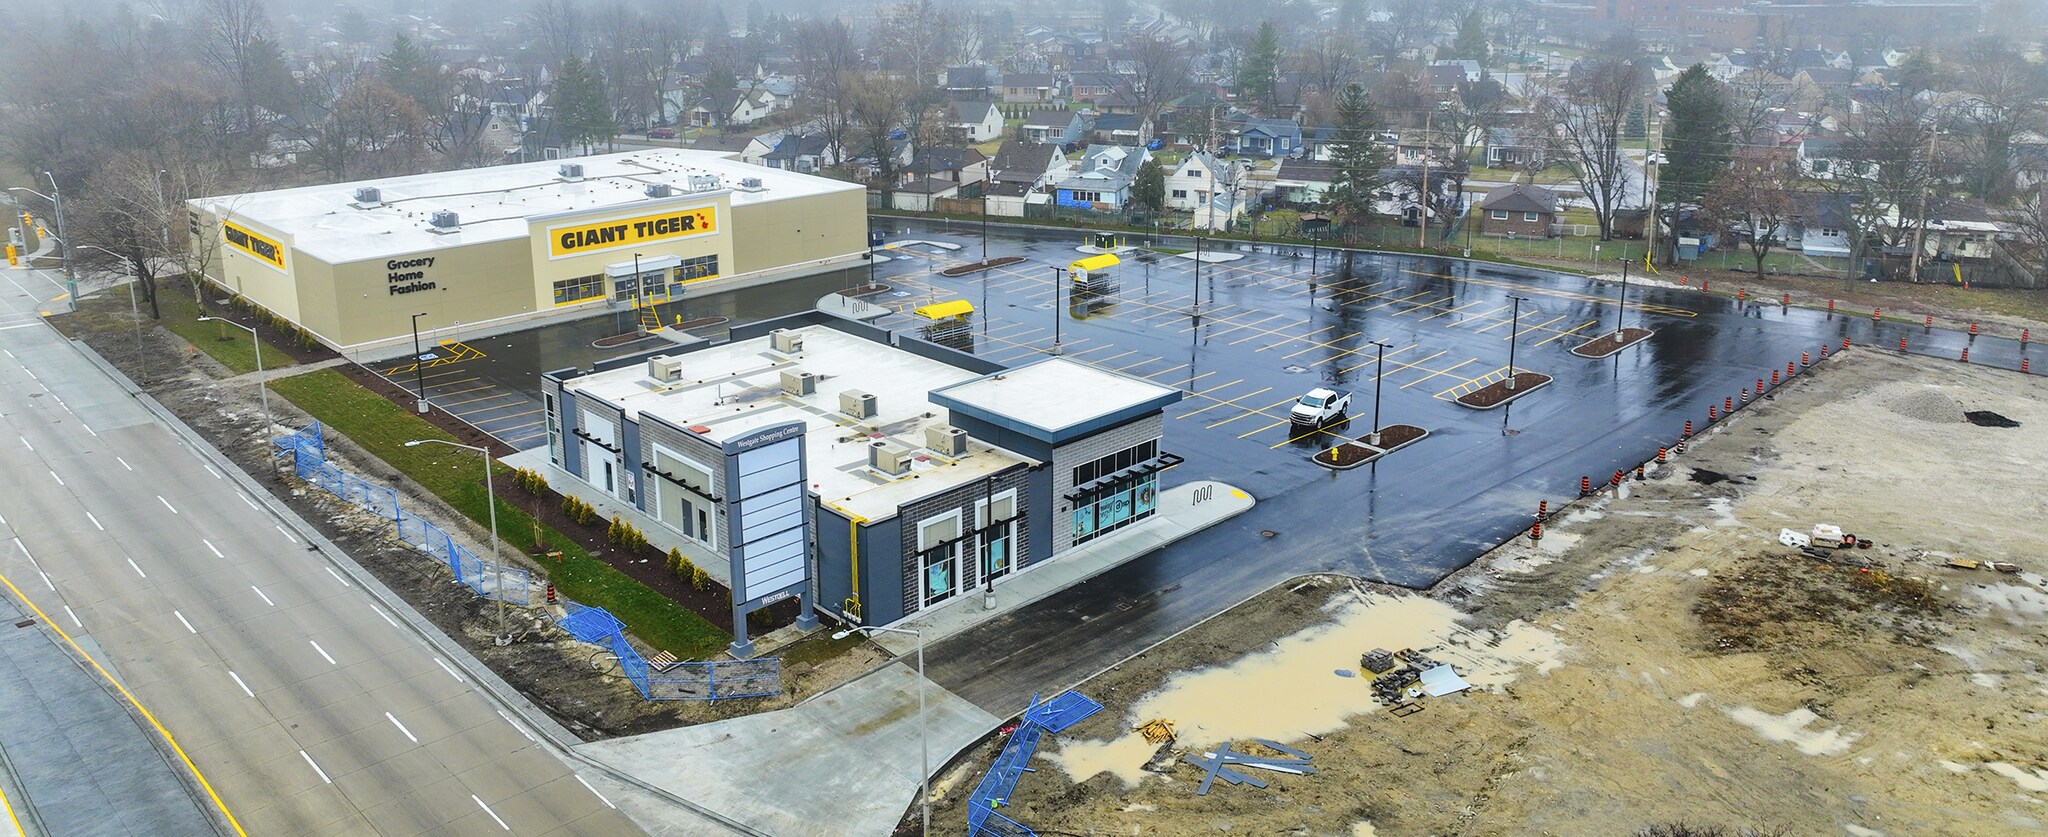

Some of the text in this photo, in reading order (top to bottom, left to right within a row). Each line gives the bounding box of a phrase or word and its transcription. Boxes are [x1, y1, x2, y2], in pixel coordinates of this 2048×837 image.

[561, 215, 695, 249] GIANT TIGER
[387, 257, 435, 270] Grocery
[388, 271, 424, 283] Home
[390, 281, 436, 296] Fashion
[737, 426, 799, 448] Westgate Shopping Centre
